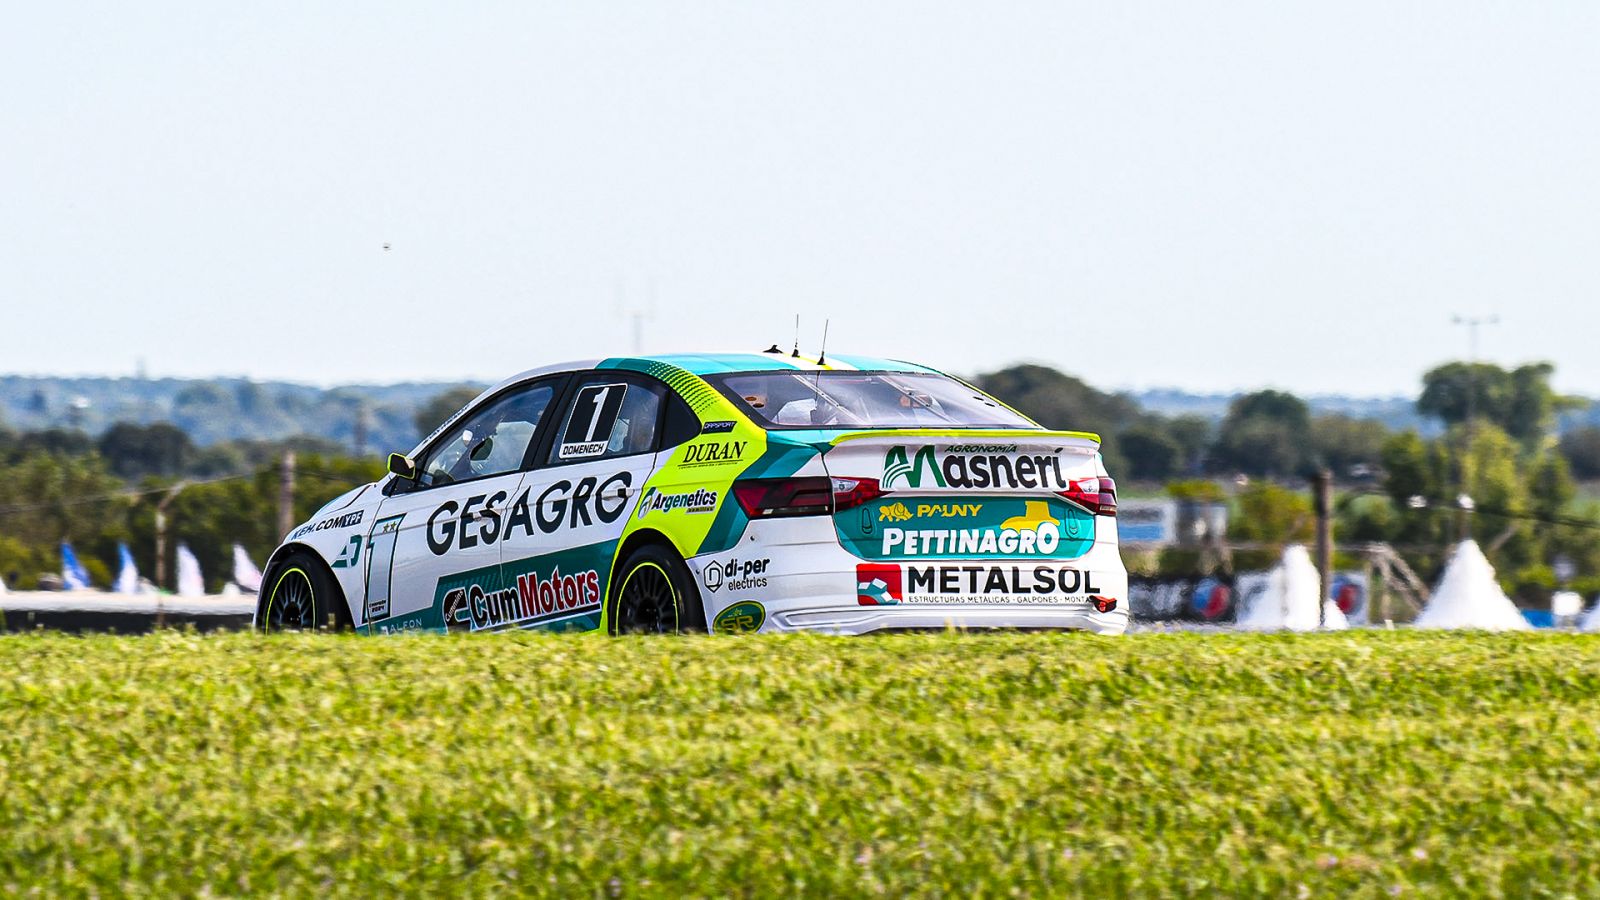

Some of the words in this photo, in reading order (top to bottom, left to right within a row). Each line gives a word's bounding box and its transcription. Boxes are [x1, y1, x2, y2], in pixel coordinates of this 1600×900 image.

[584, 387, 610, 442] 1
[562, 443, 605, 456] DOMENECH
[683, 441, 747, 463] DURAN
[944, 444, 1018, 454] AGRONOMÍA
[883, 444, 1067, 490] Masneri
[651, 488, 717, 513] Argenetics
[917, 504, 983, 517] PAUNY
[344, 512, 362, 527] YPF
[426, 471, 632, 556] GESAGRO
[882, 521, 1061, 556] PETTINAGRO
[724, 558, 770, 580] di-per
[908, 565, 1101, 595] METALSOL
[728, 576, 768, 592] electrics
[445, 590, 464, 622] Cummins
[908, 595, 965, 604] ESTRUCTURAS
[1017, 595, 1059, 604] GALPONES
[1064, 595, 1092, 604] MONTA
[390, 617, 423, 633] ALFON
